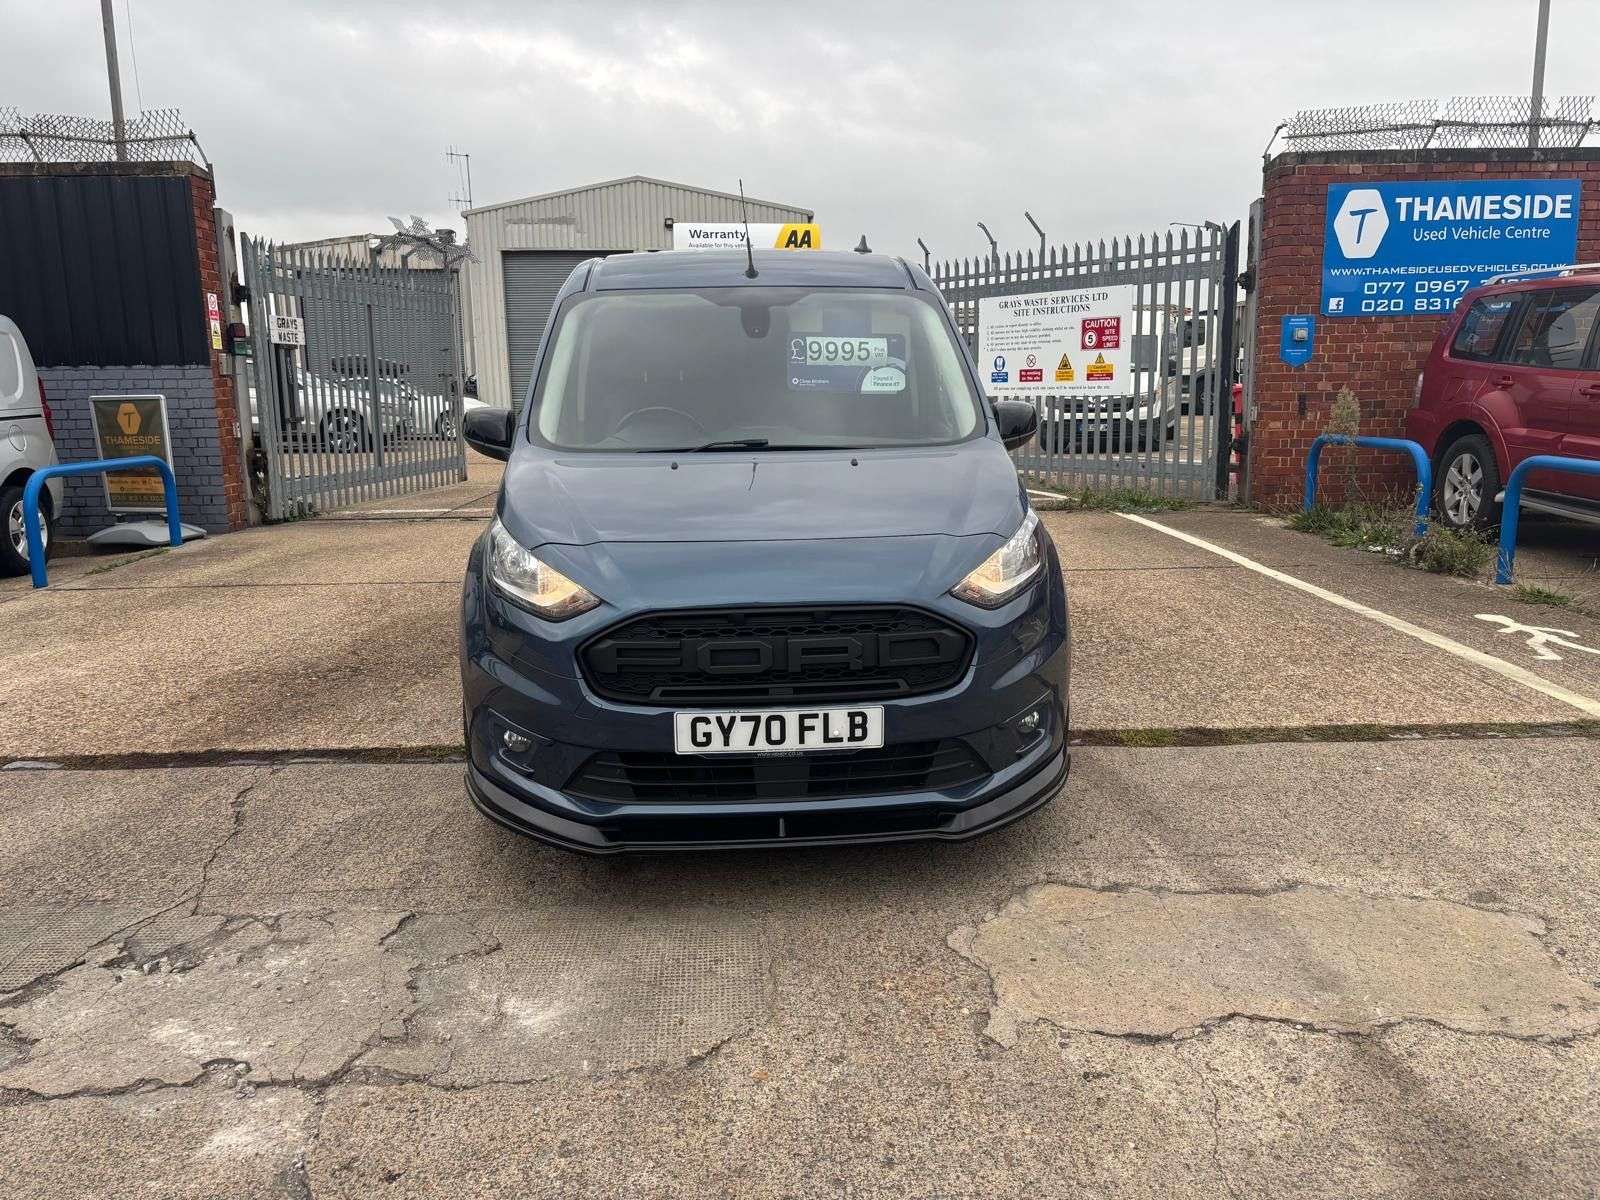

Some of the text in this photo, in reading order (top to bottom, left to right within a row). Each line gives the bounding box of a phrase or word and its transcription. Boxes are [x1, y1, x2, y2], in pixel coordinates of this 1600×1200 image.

[1396, 194, 1572, 222] THAMESIDE
[689, 229, 746, 241] Warranty
[785, 230, 811, 248] AA
[1413, 225, 1550, 242] Used Vehicle Centre
[1364, 281, 1405, 295] 077
[1415, 280, 1469, 293] 0967
[999, 292, 1108, 310] GRAYS WASTE SERVICES LTD
[1362, 299, 1404, 312] 020
[1013, 304, 1091, 317] SITE INSTRUCTIONS
[277, 318, 298, 330] GRAYS
[1085, 319, 1118, 329] CAUTION
[279, 331, 299, 343] WASTE
[1087, 334, 1094, 344] 5
[104, 435, 161, 446] THAMESIDE
[592, 629, 966, 674] FORD
[690, 711, 868, 747] GY70 FLB
